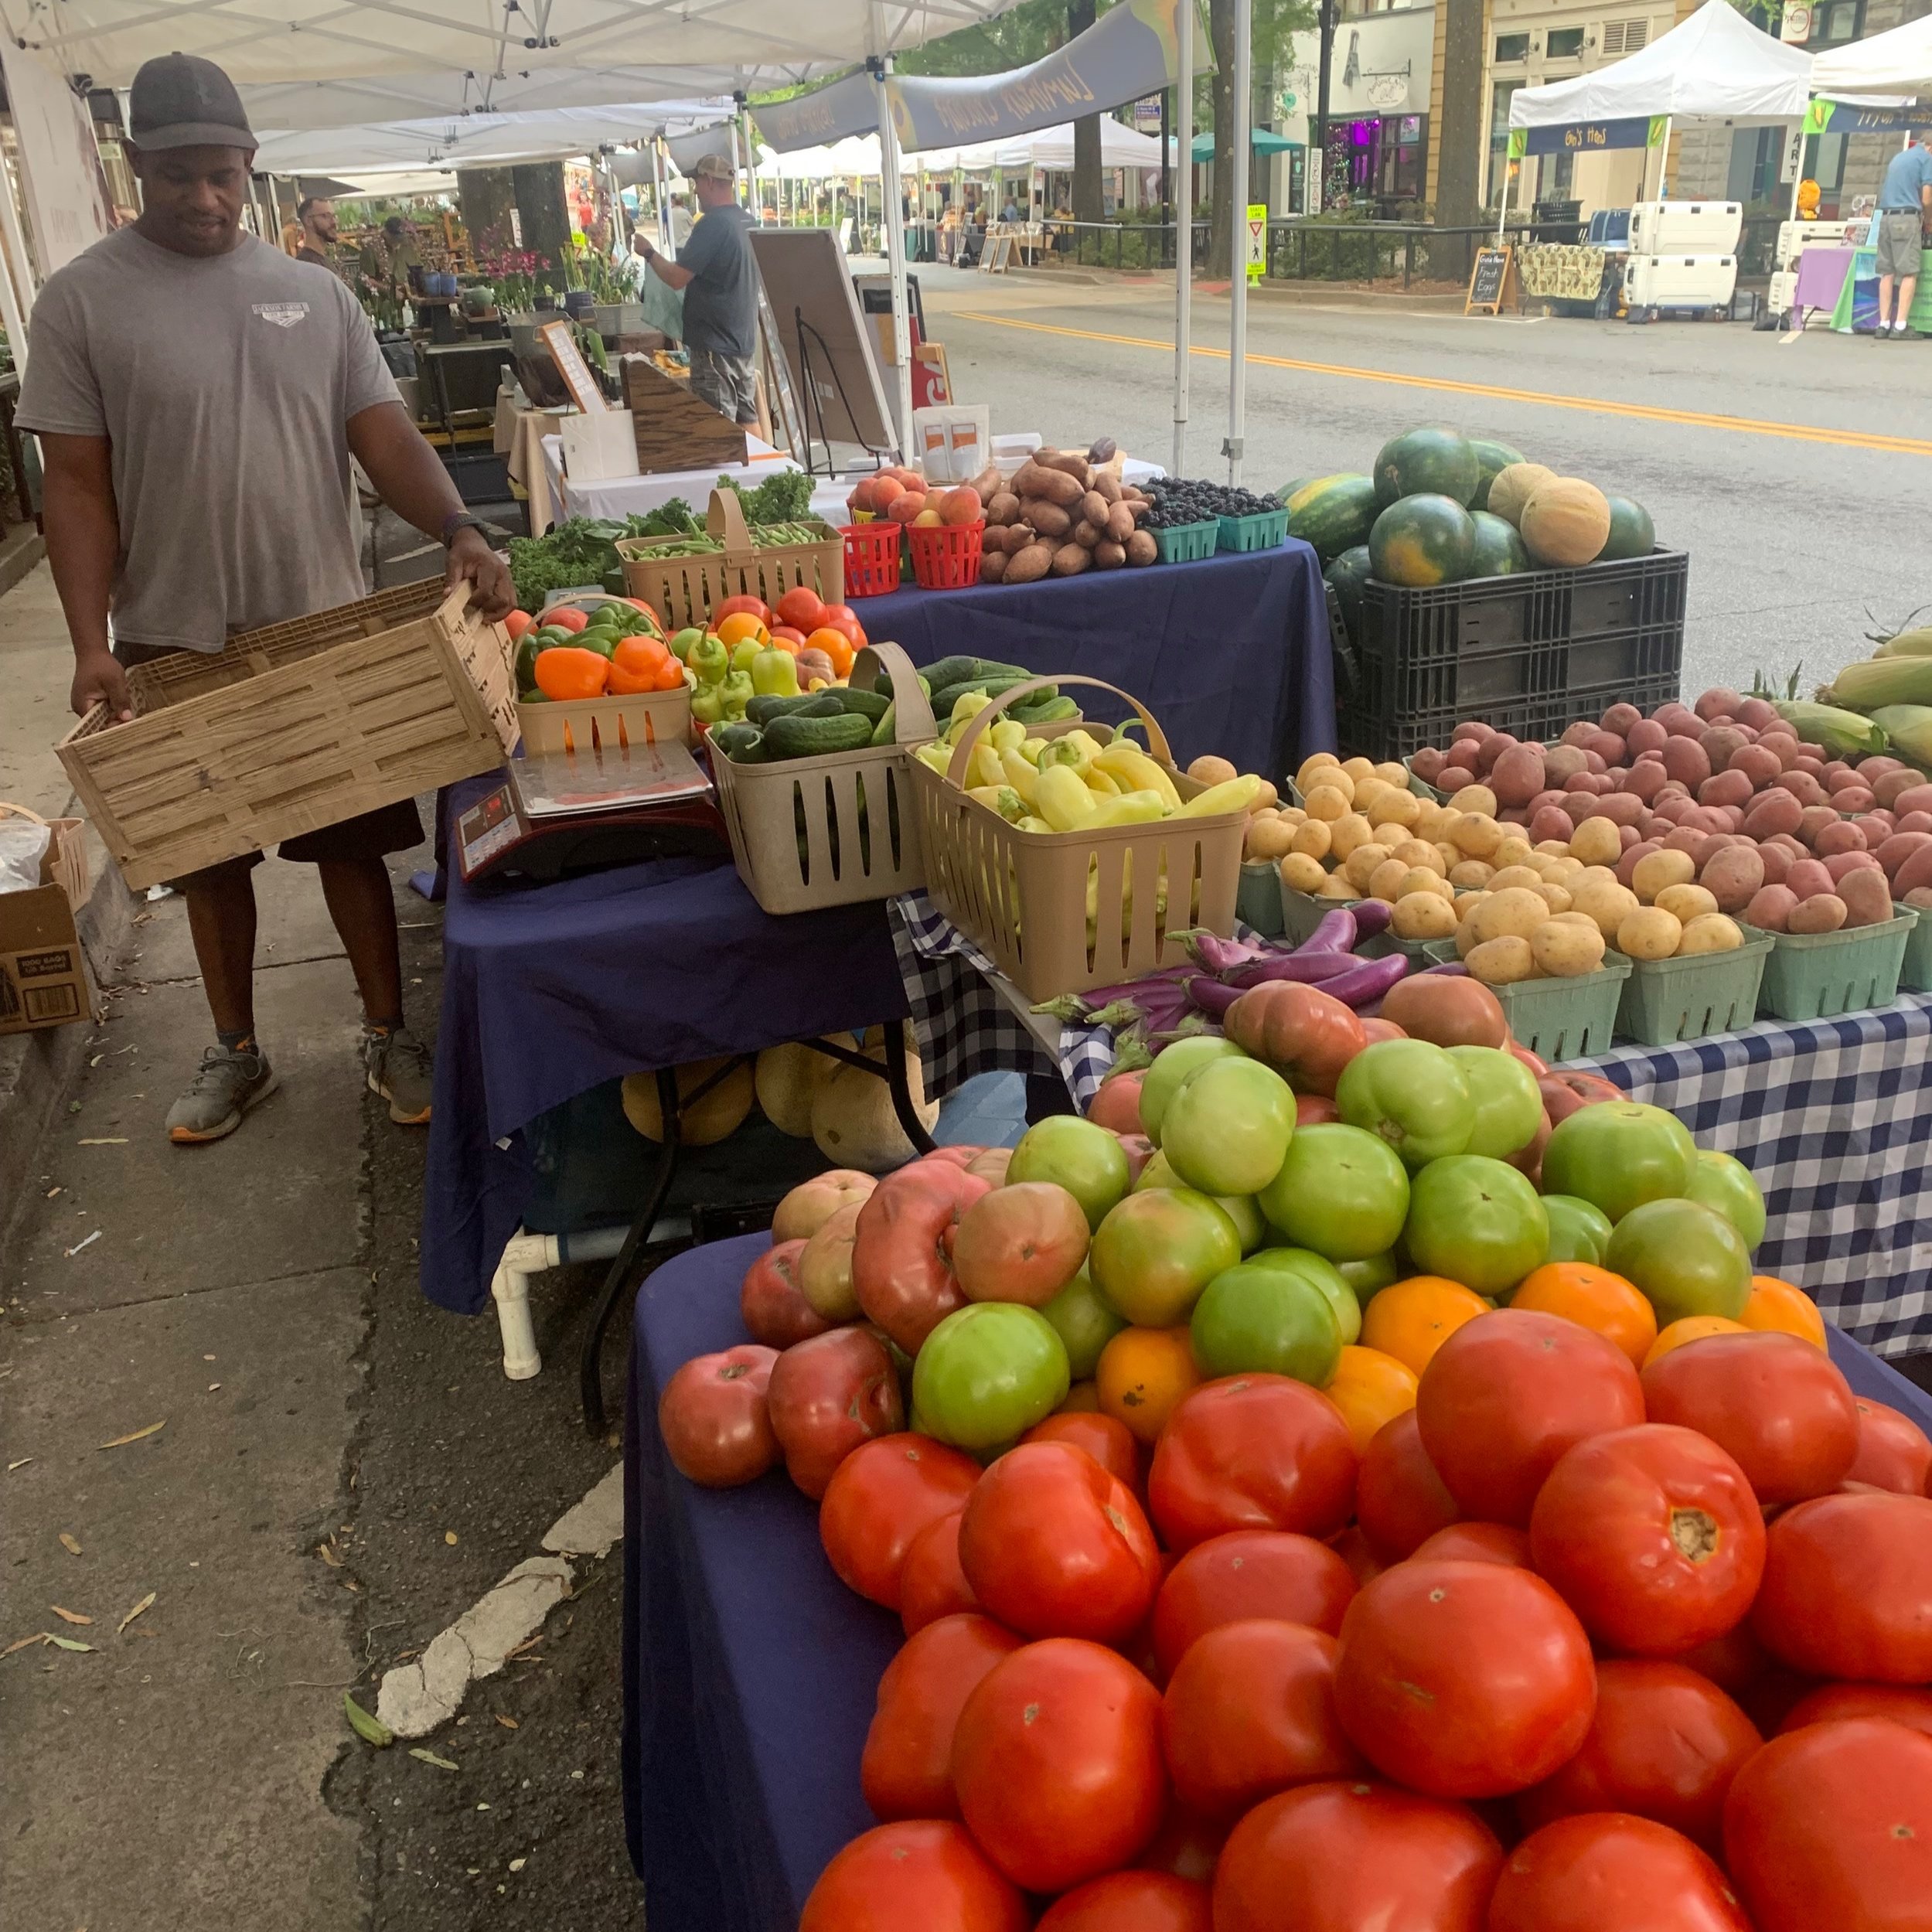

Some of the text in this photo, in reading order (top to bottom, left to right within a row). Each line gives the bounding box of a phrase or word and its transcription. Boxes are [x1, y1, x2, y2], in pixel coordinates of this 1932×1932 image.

[1587, 126, 1607, 145] Hens
[1477, 266, 1498, 278] Fresh
[1477, 279, 1496, 294] Eggs
